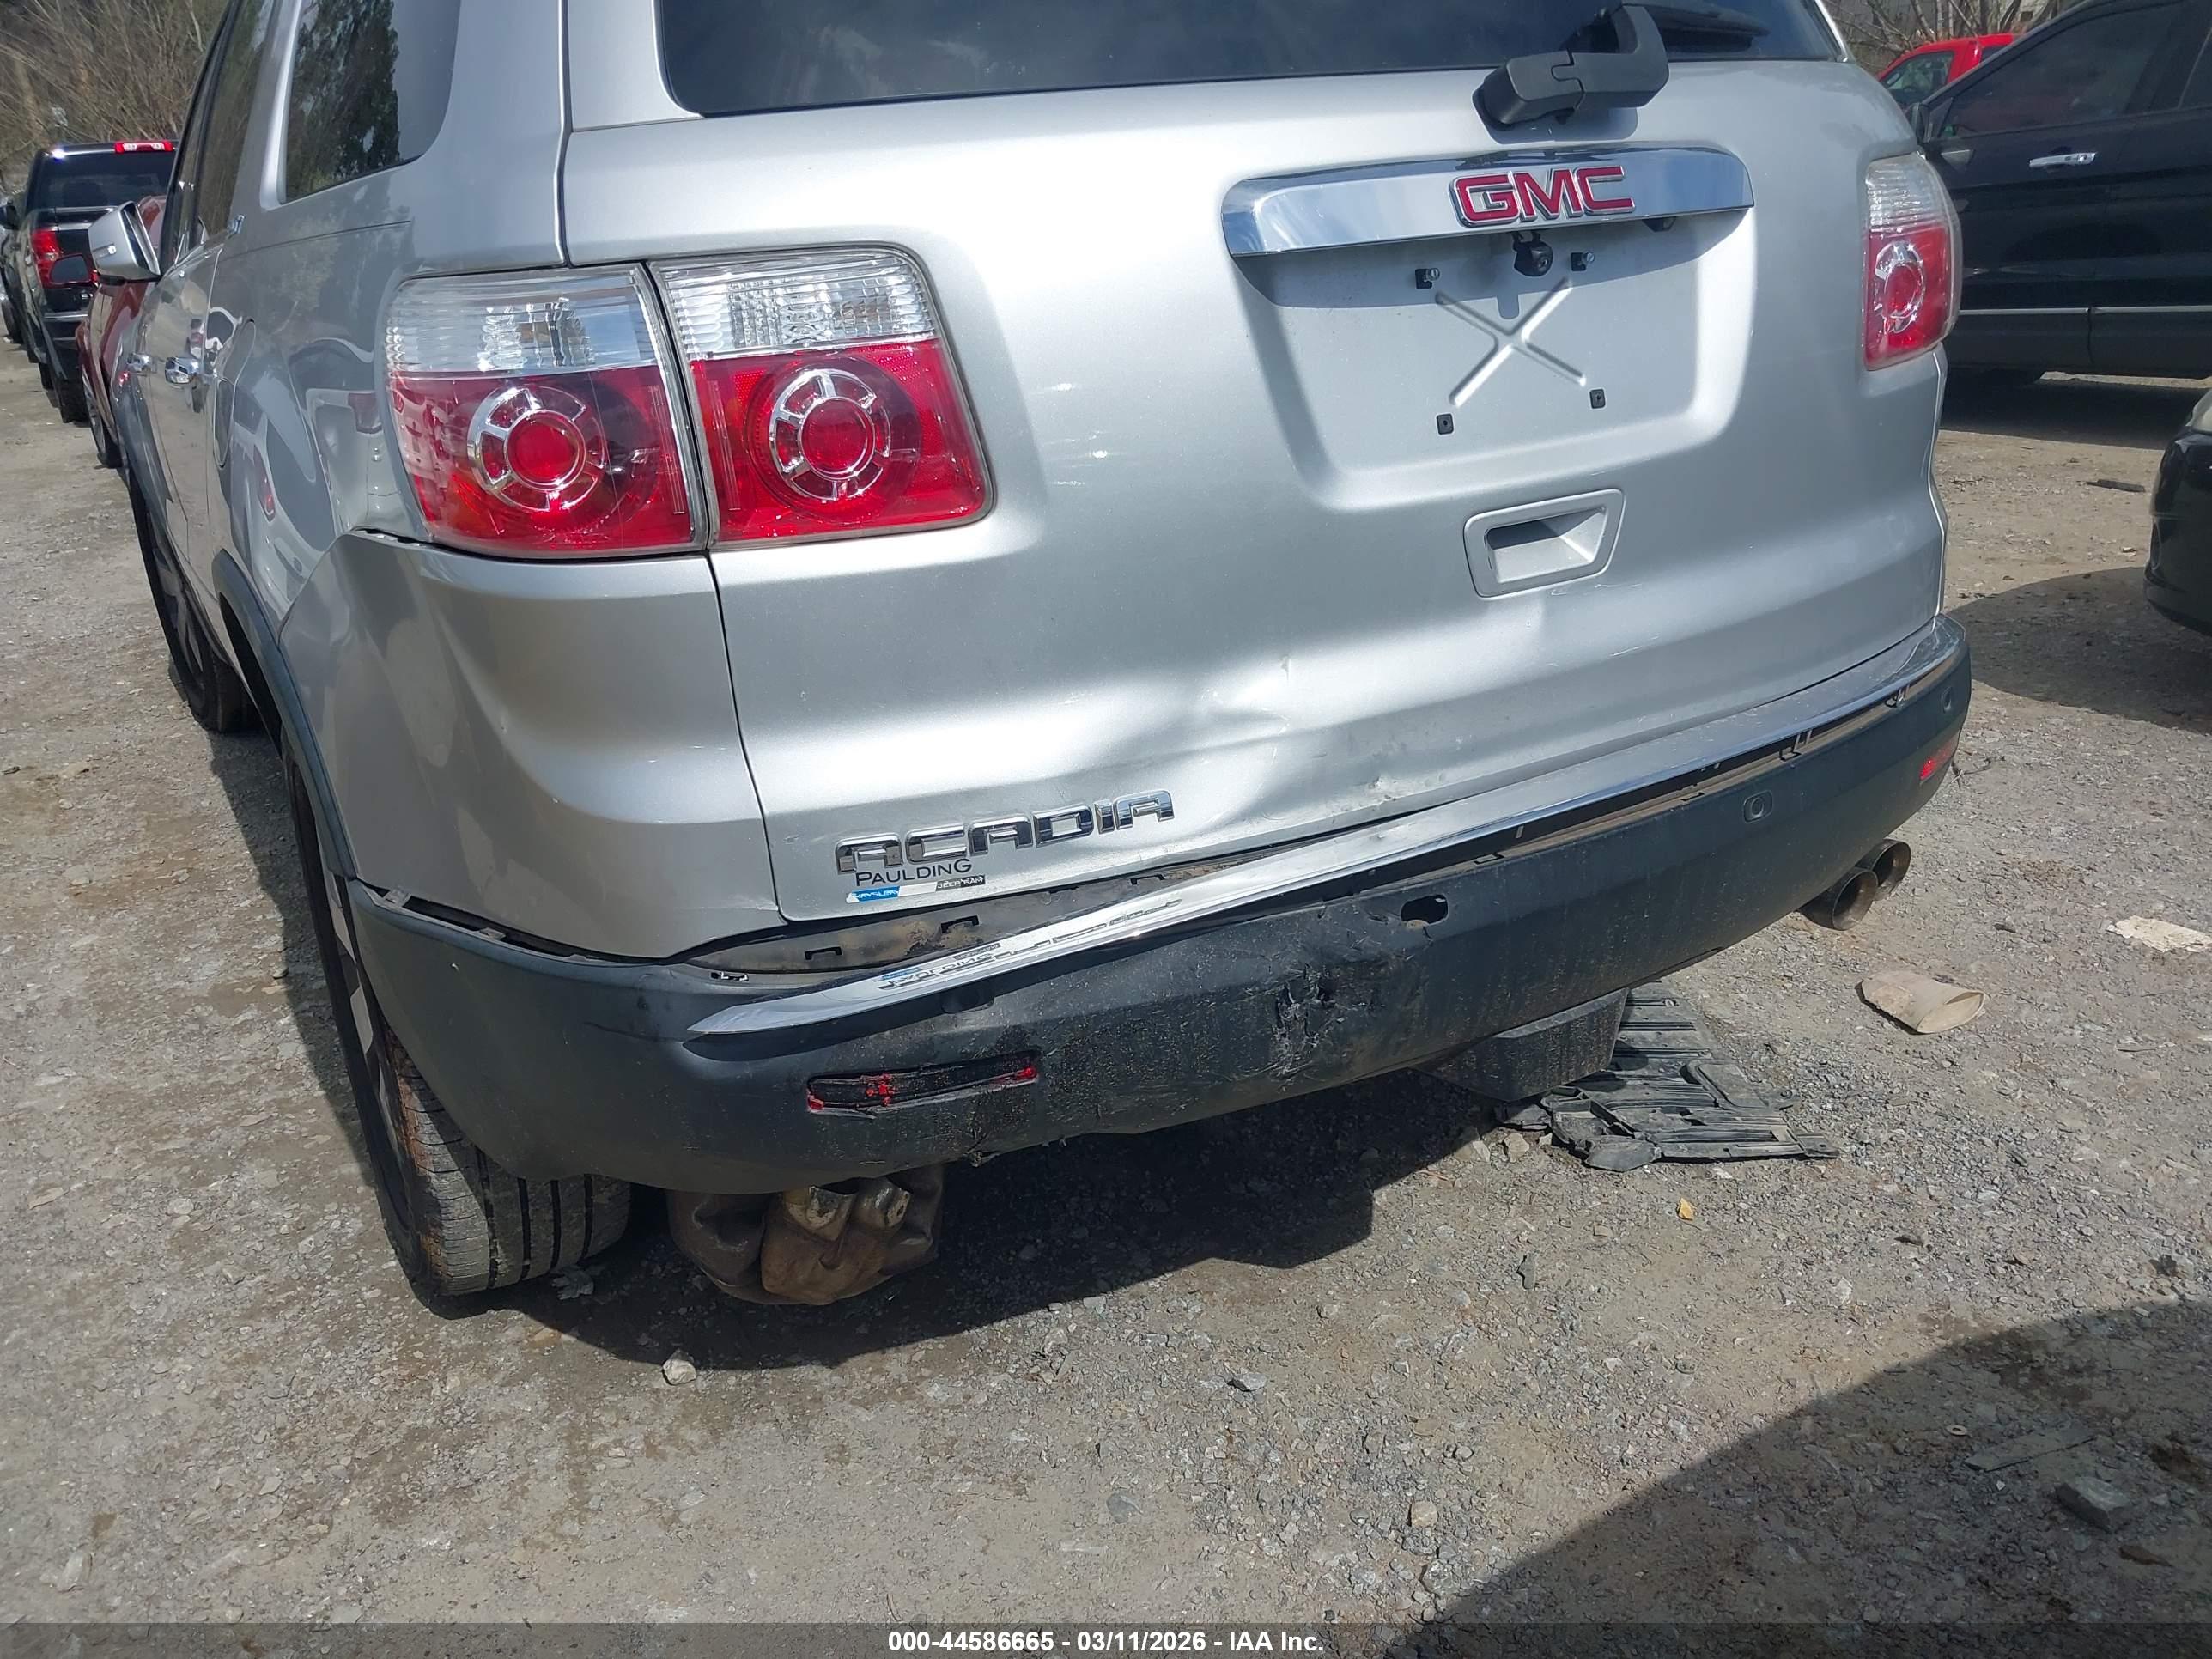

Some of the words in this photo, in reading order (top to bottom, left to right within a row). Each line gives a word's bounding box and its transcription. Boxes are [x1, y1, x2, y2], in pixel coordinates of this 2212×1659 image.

[1449, 165, 1635, 228] GMC
[835, 790, 1175, 875] ACADIA
[856, 859, 972, 886] PAULDING
